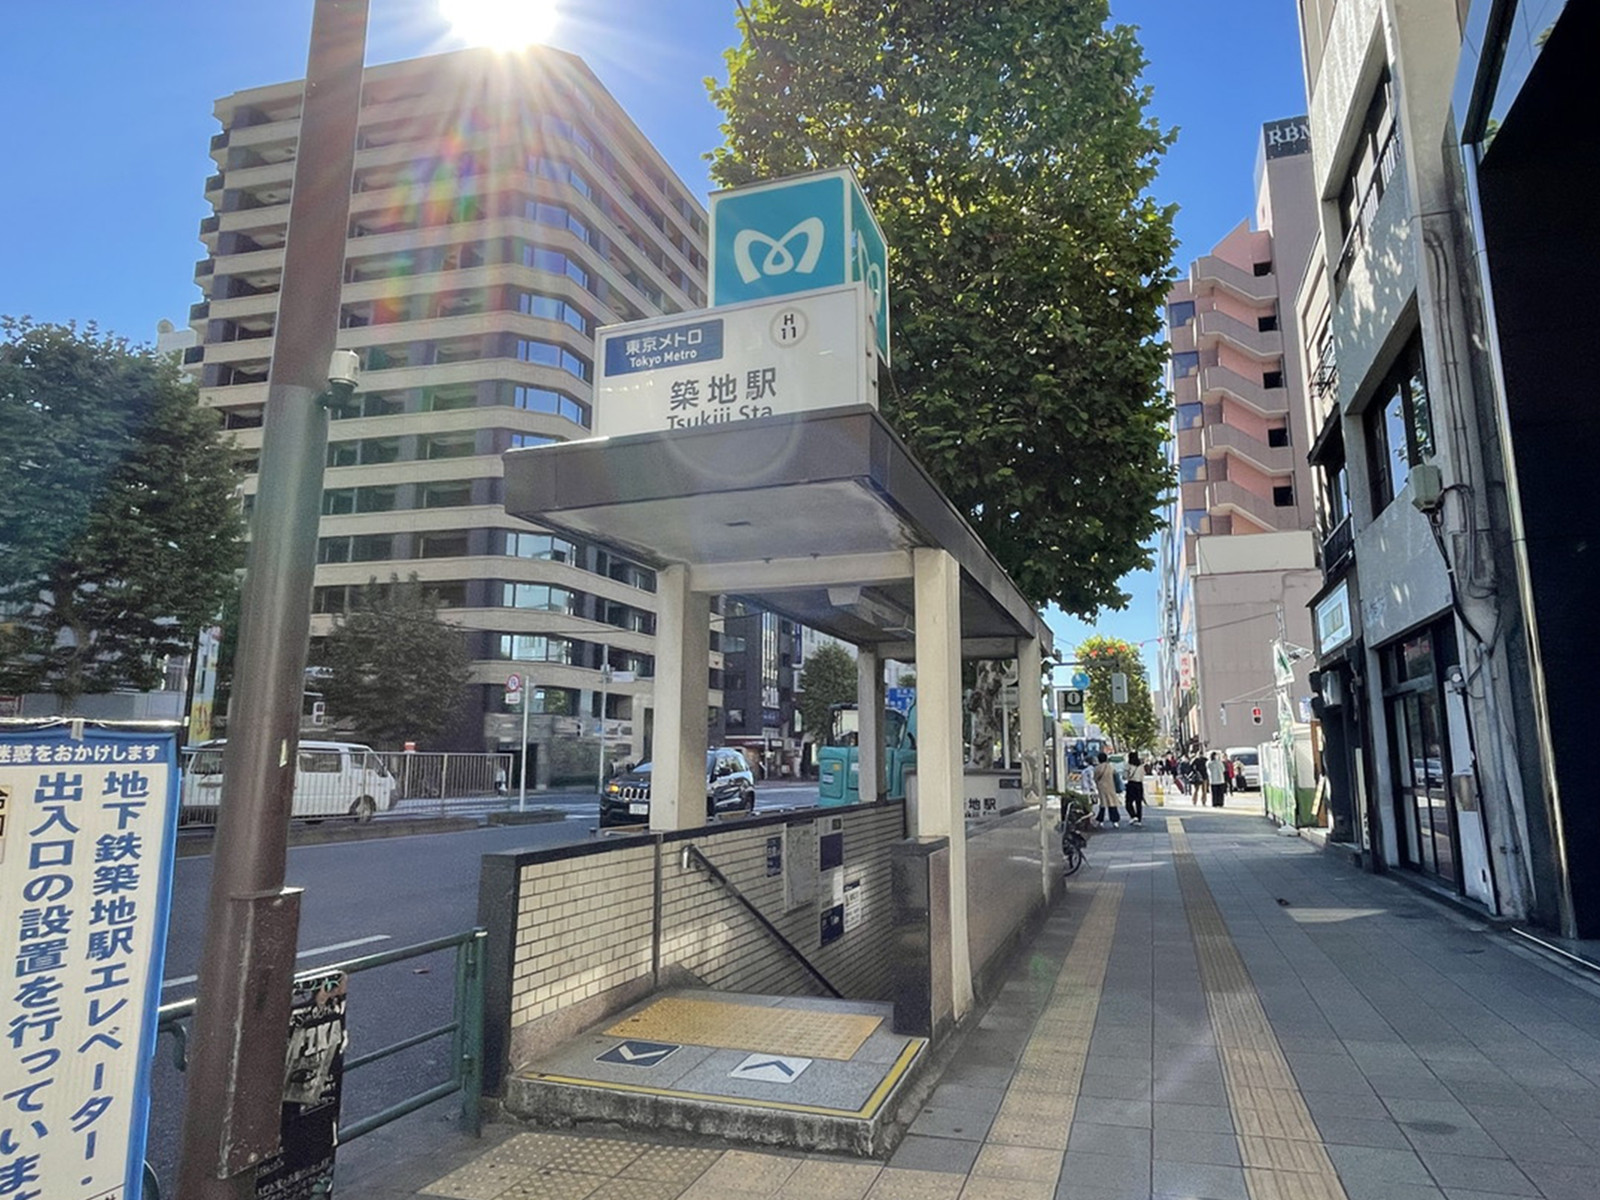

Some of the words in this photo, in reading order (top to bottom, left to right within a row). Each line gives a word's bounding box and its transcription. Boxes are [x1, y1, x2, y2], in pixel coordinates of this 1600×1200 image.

[783, 313, 794, 325] H
[781, 326, 797, 340] 11
[625, 328, 702, 355] 東京メトロ
[629, 354, 661, 368] Tokyo
[664, 349, 697, 363] Metro
[670, 367, 776, 411] 築地駅
[964, 797, 997, 811] 地駅
